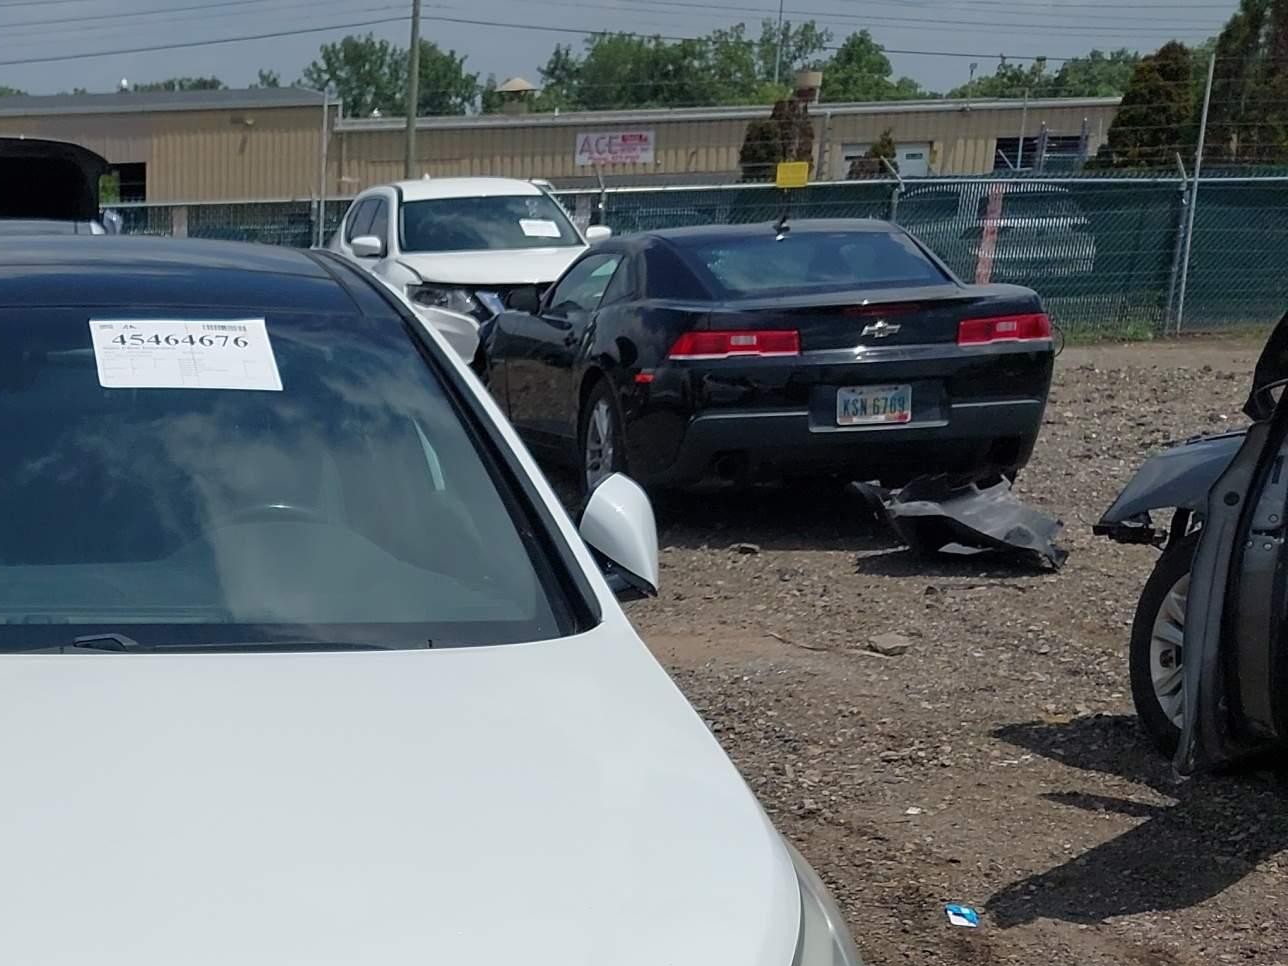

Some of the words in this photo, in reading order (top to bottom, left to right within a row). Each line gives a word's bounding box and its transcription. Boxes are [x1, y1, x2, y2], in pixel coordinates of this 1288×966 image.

[579, 134, 619, 155] ACE
[112, 333, 249, 348] 45464676
[843, 397, 867, 417] KSN
